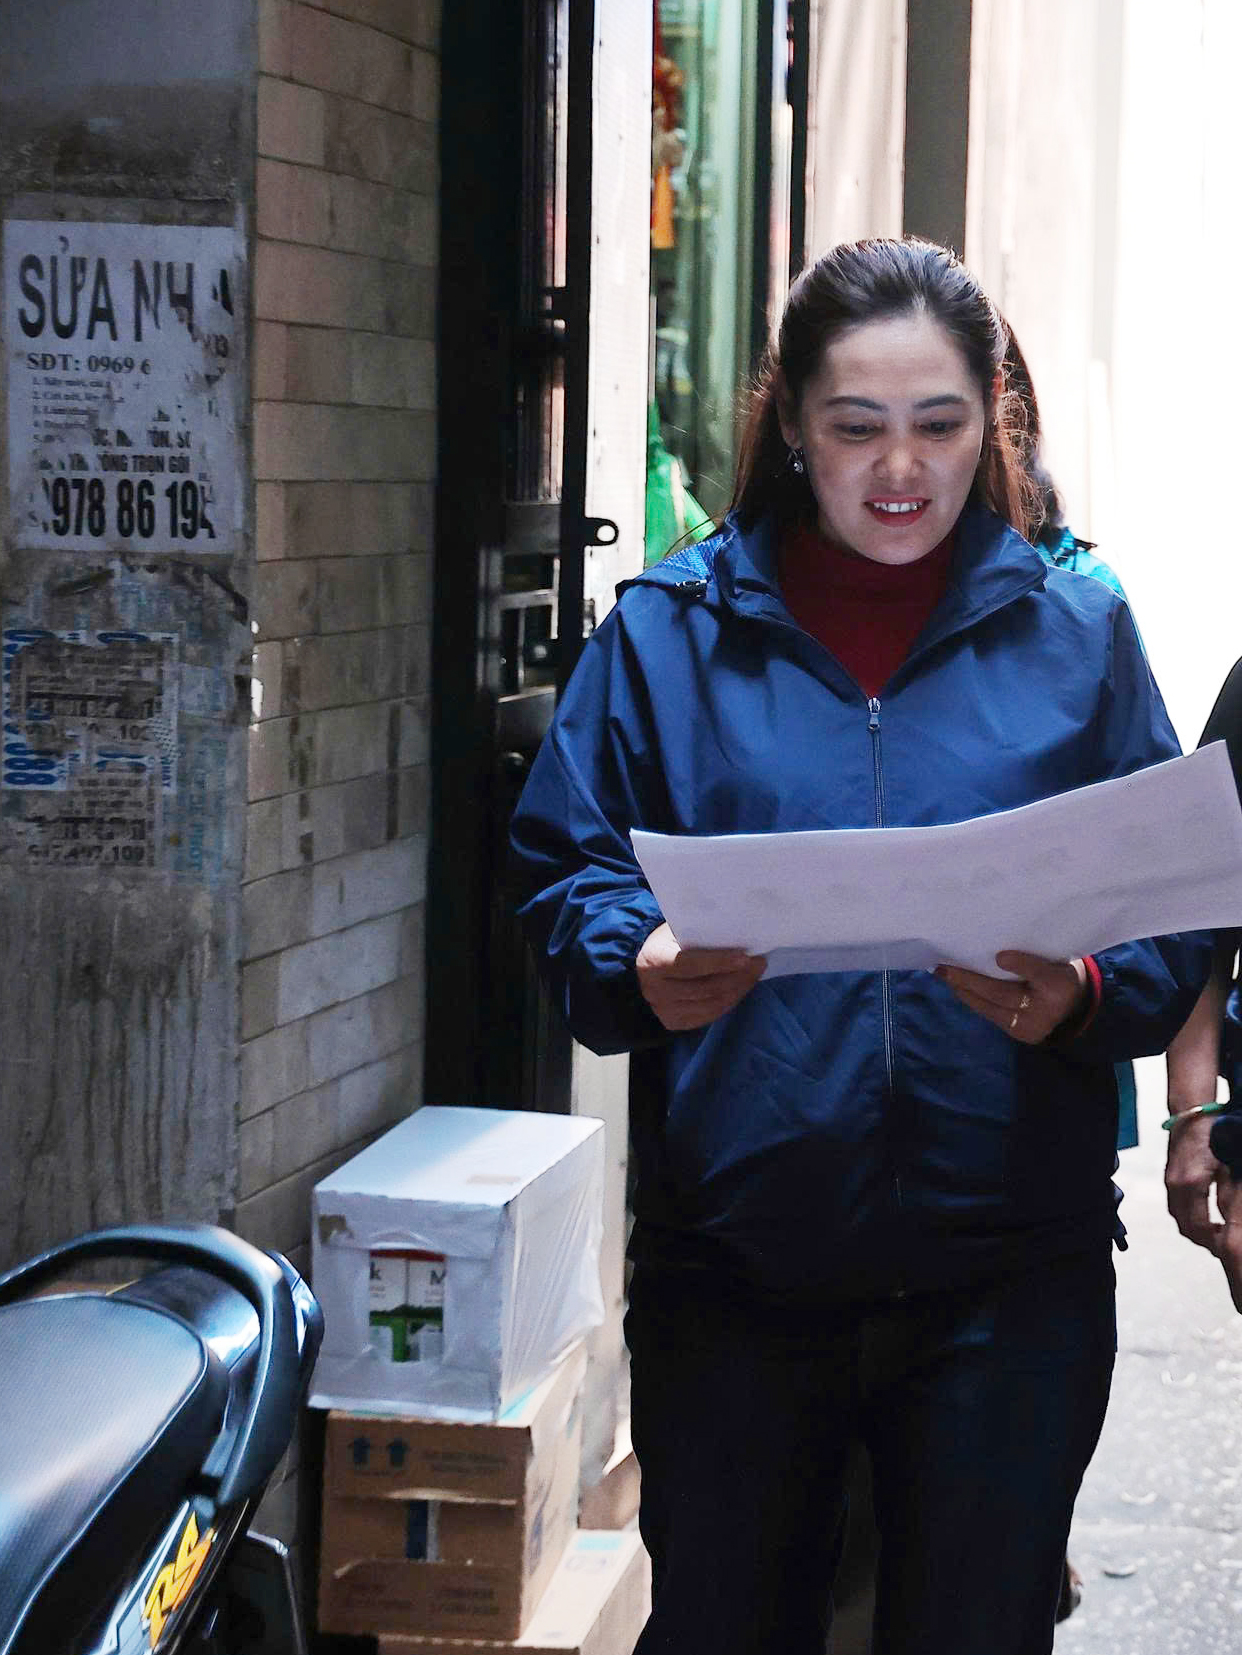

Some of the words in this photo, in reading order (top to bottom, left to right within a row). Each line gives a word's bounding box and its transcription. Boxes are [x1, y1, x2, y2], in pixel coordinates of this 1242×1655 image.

[18, 234, 119, 340] SỬA
[87, 355, 136, 374] 0969
[116, 479, 155, 539] 86
